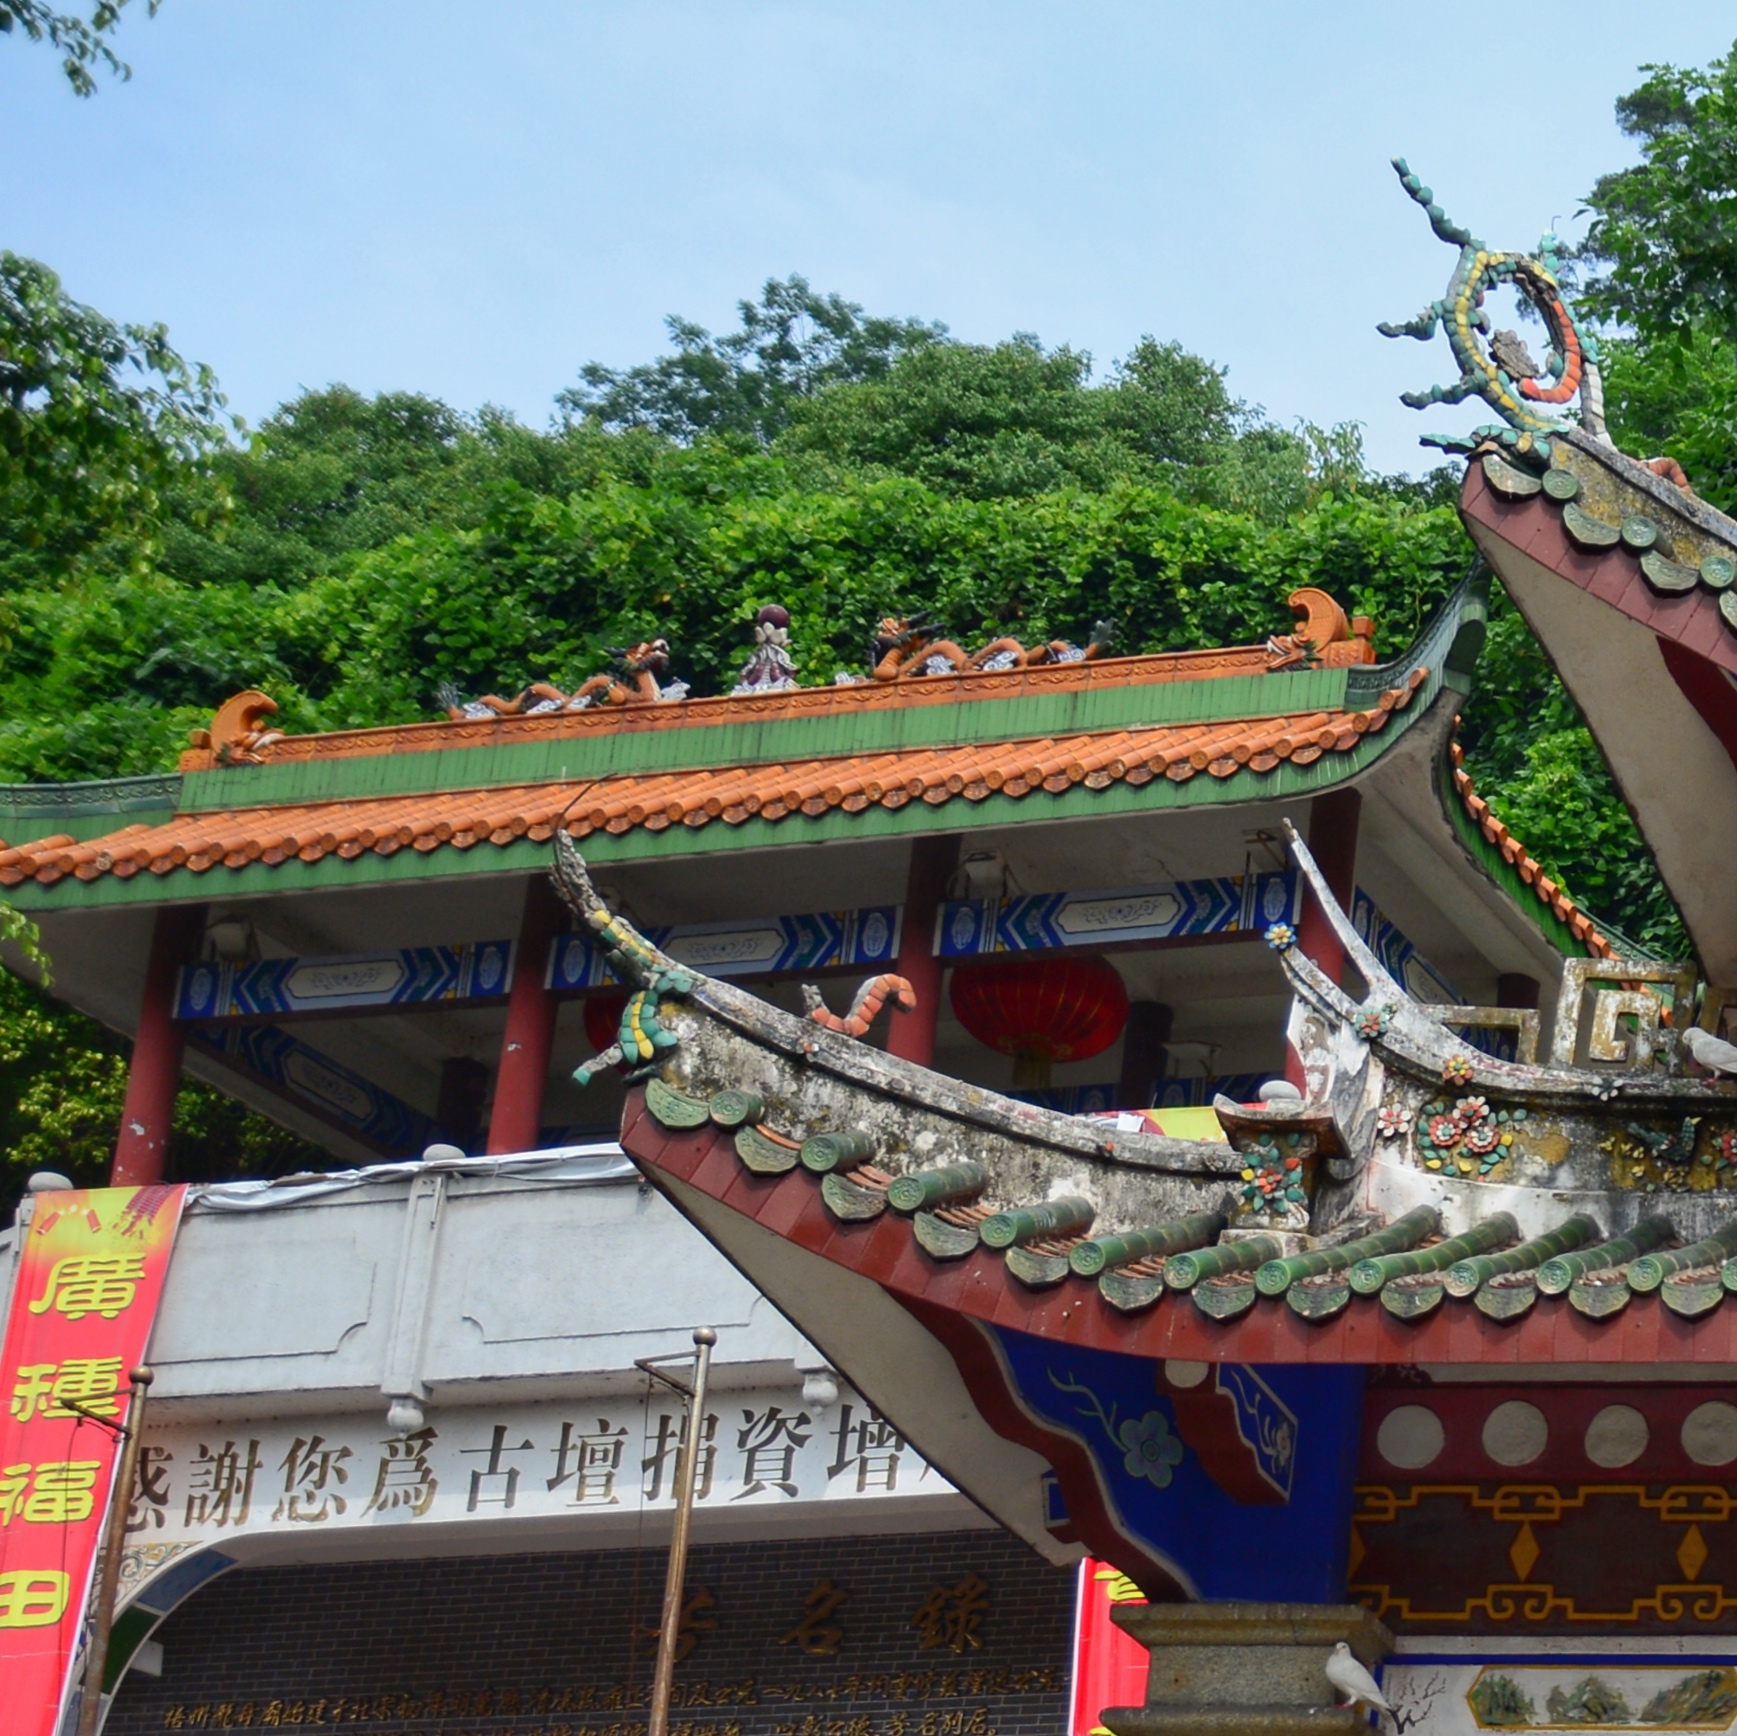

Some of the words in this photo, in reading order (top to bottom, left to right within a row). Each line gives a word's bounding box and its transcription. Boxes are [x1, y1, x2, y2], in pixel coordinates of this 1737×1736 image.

[125, 1403, 942, 1533] 感謝您爲古壇捐資增
